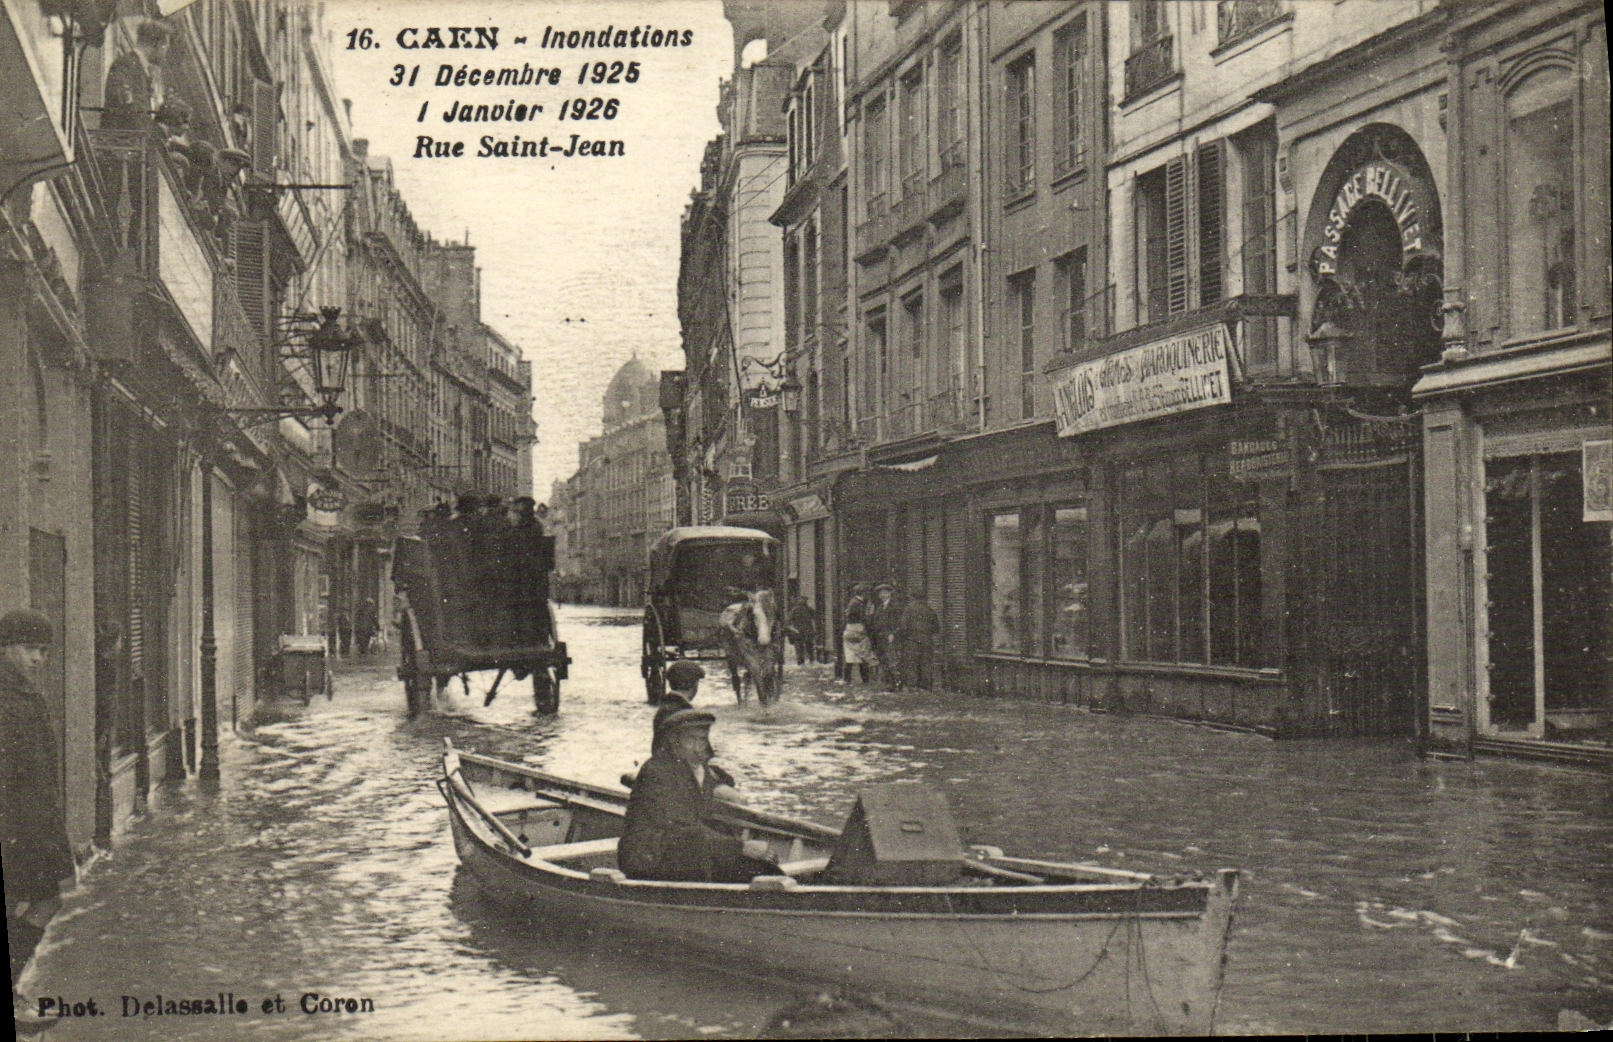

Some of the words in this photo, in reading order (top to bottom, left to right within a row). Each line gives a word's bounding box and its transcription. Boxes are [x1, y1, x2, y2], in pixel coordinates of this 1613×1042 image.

[1318, 172, 1363, 275] PASSAGE
[1365, 166, 1422, 252] BELLIVET
[1140, 329, 1224, 383] MAROQUINERIE
